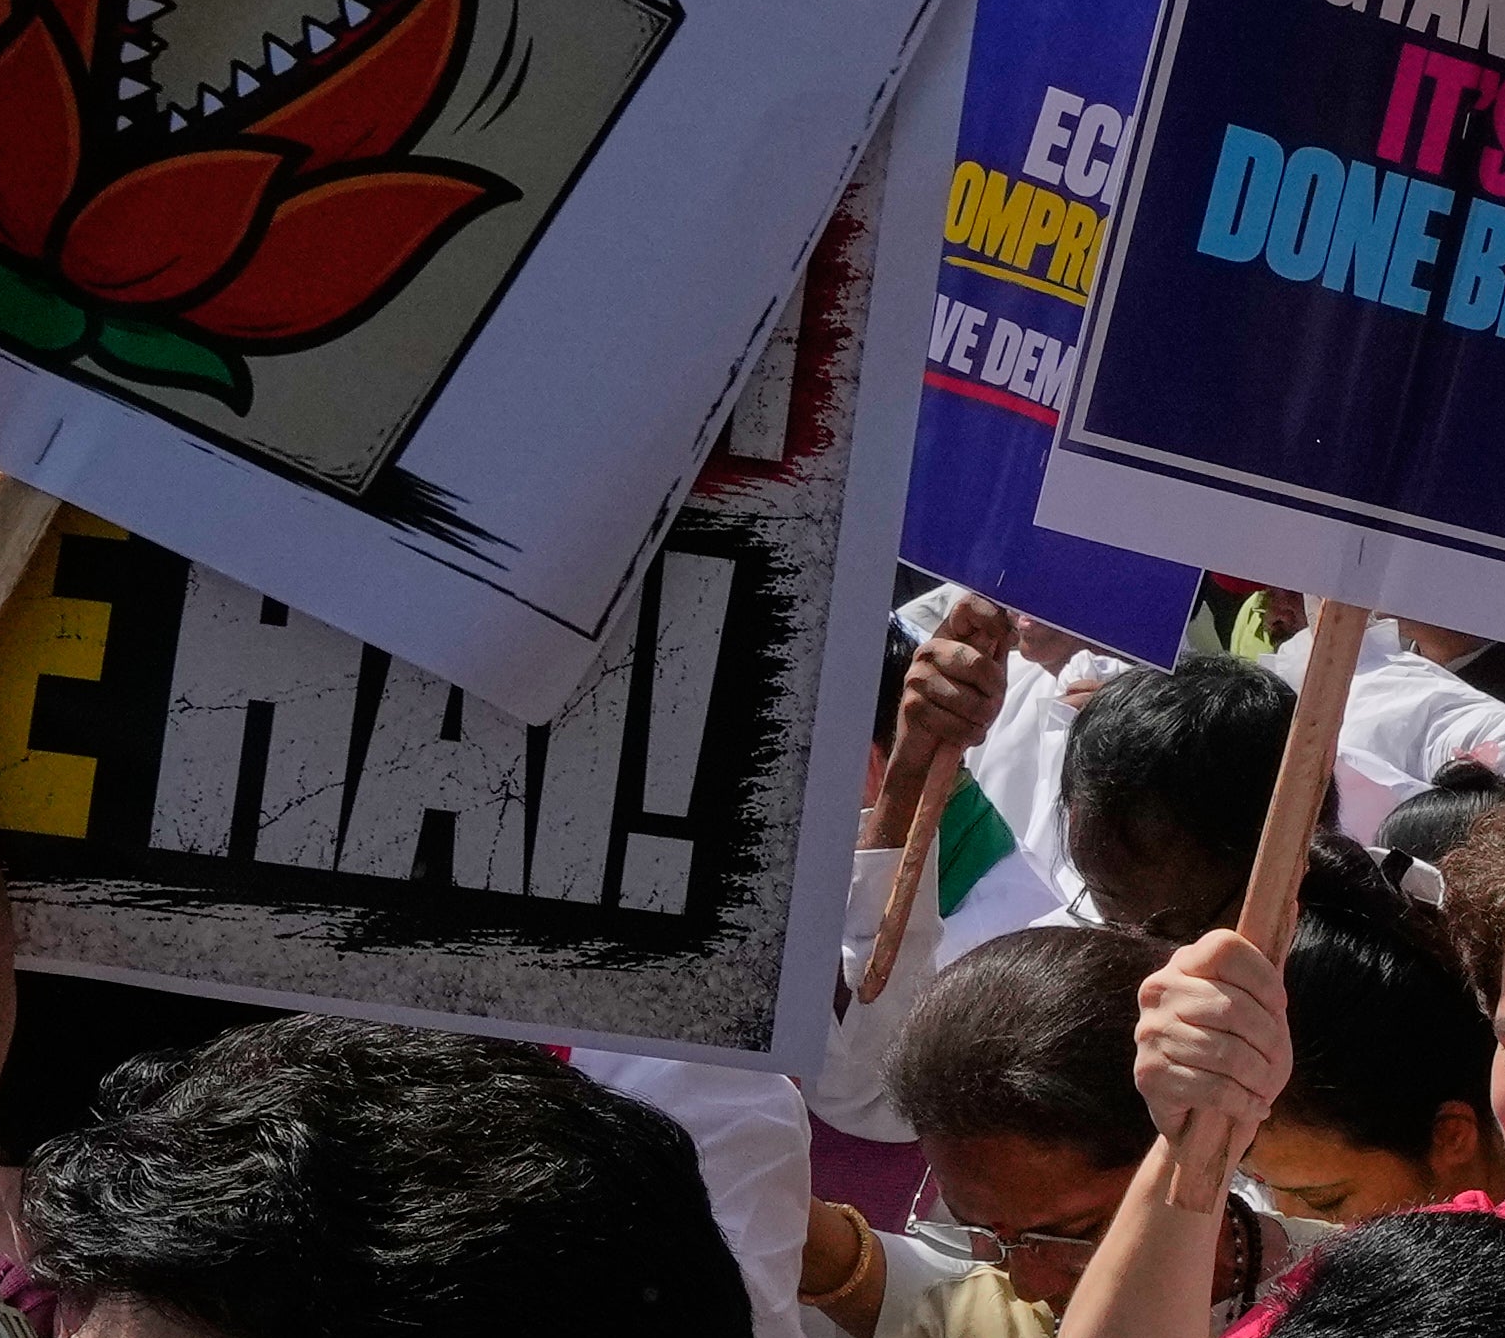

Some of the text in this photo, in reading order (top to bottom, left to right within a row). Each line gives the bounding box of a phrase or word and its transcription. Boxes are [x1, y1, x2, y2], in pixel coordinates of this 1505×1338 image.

[1197, 123, 1456, 316] DONE
[927, 294, 1078, 411] VE DEM
[149, 550, 737, 915] HAI!
